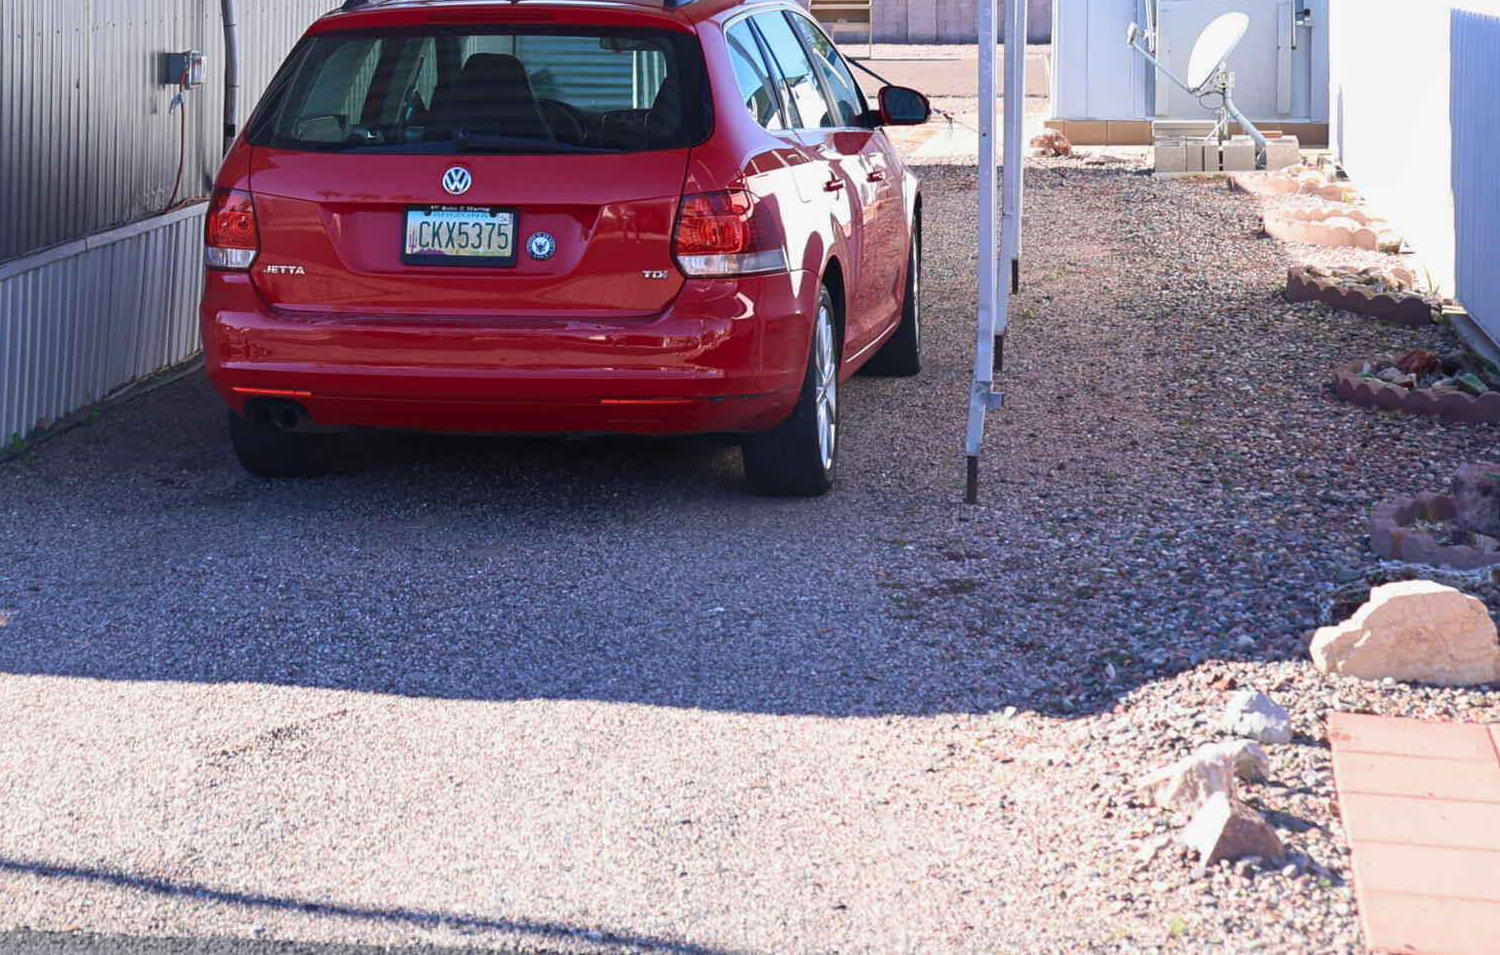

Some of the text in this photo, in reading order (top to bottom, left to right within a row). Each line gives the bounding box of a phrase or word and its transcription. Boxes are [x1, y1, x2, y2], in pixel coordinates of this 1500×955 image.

[442, 166, 472, 195] VW
[433, 211, 489, 219] ARIZONA
[418, 221, 509, 250] CKX5375
[262, 265, 306, 275] JETTA
[641, 269, 669, 280] TDI
